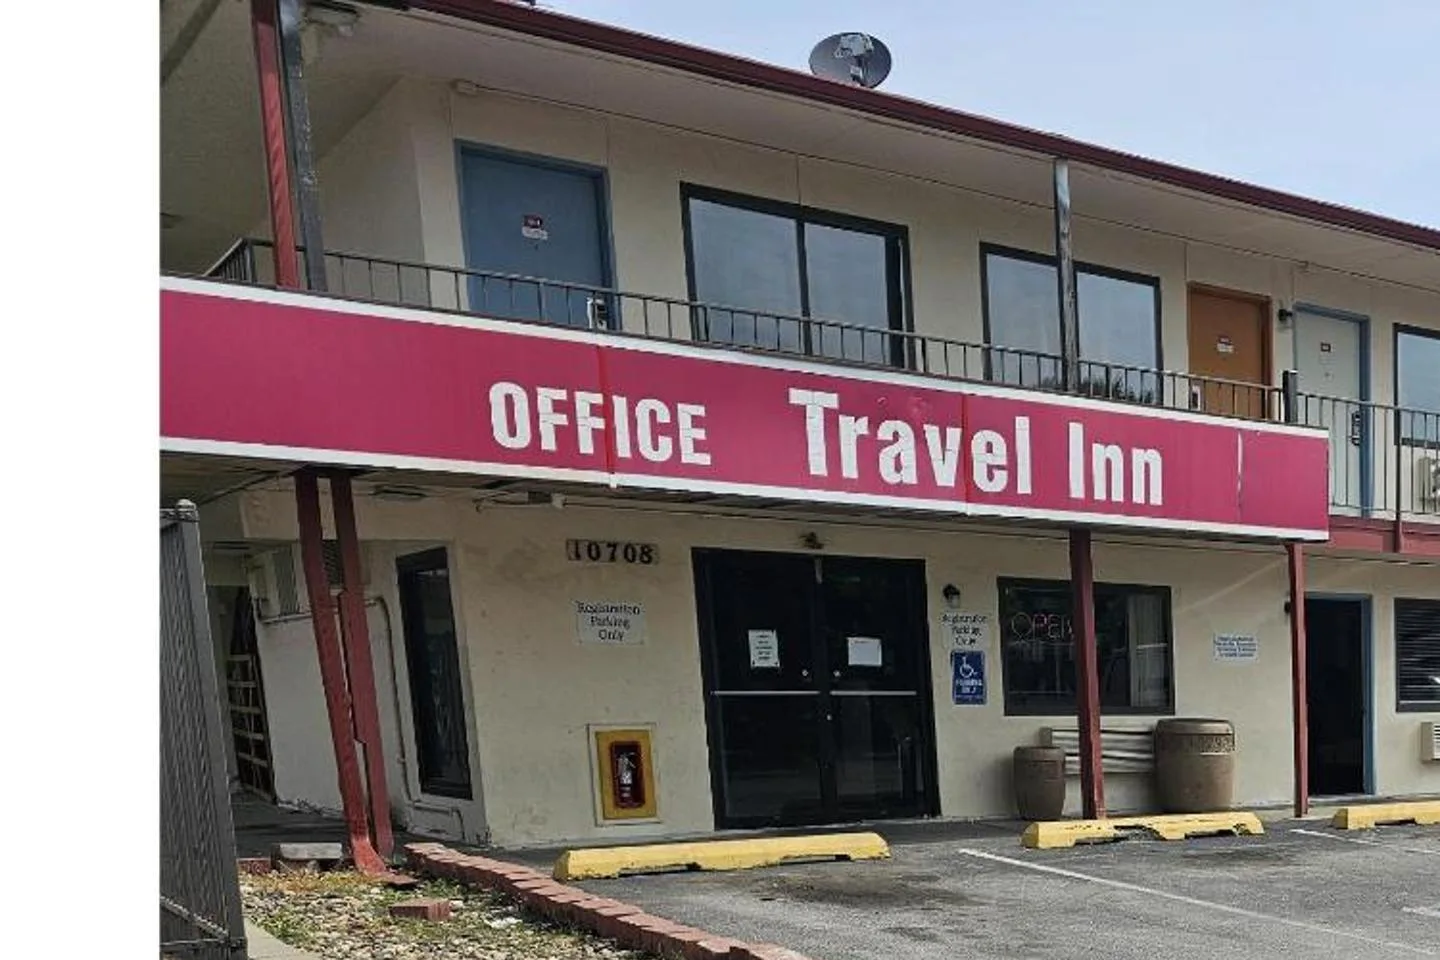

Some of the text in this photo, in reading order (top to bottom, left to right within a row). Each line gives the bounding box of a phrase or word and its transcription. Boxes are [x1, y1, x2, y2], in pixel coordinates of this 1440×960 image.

[489, 381, 711, 465] OFFICE
[788, 387, 1163, 506] Travel Inn
[574, 540, 654, 565] 10708
[599, 630, 625, 641] Only
